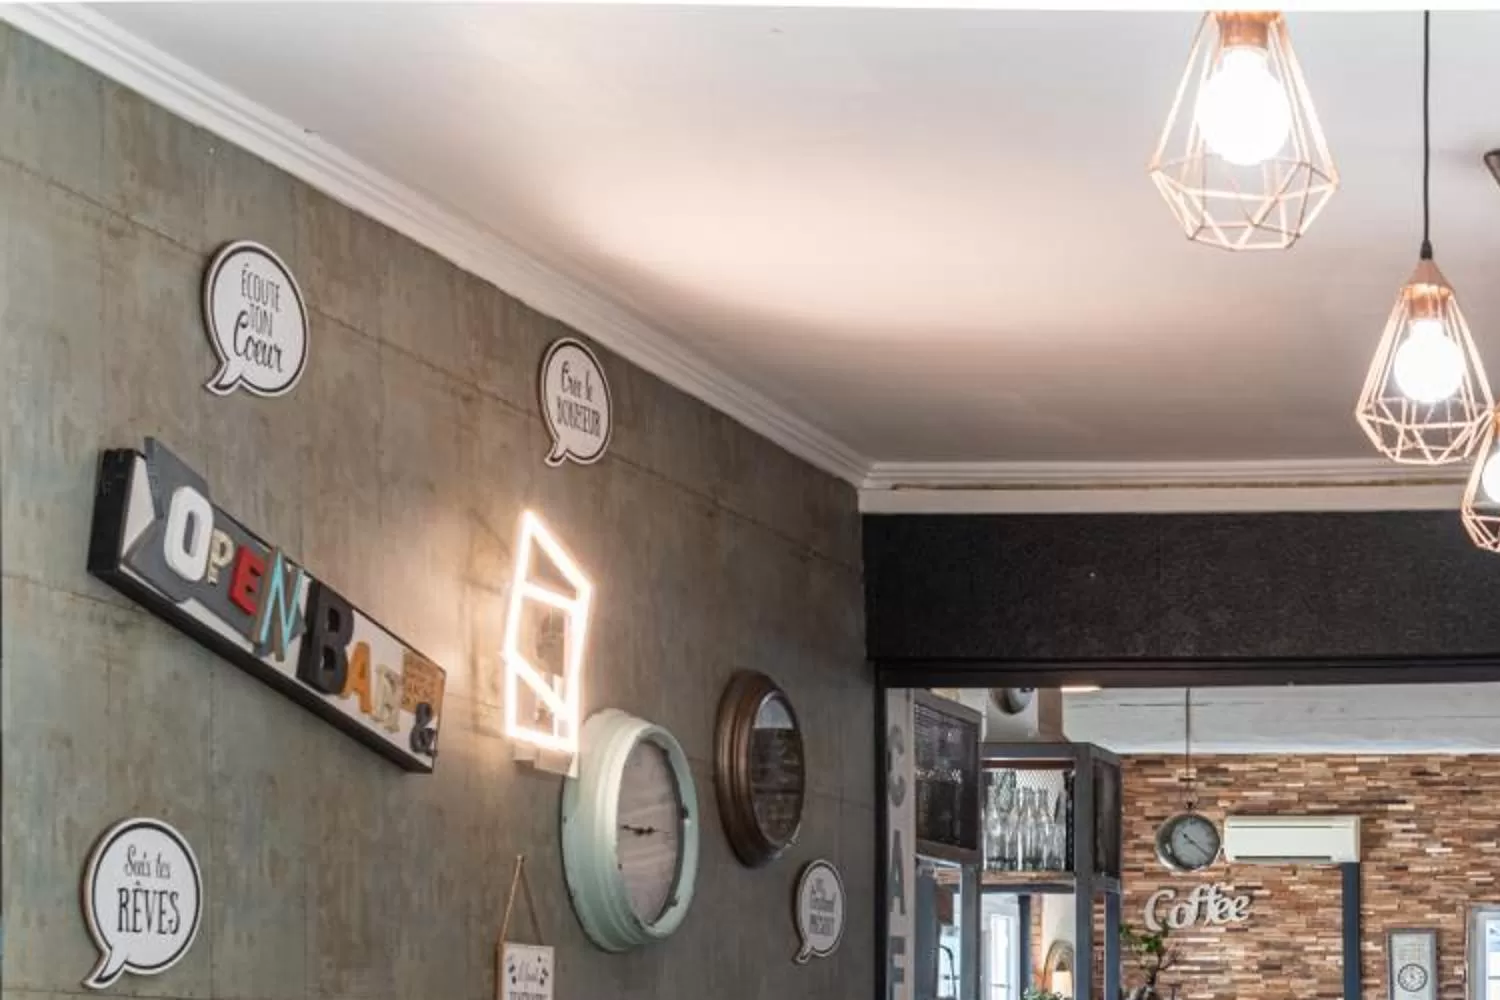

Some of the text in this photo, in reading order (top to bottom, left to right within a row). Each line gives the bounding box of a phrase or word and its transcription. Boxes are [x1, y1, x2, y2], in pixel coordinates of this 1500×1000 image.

[241, 263, 280, 312] ÉCOUTE
[249, 303, 273, 337] TON
[164, 485, 304, 663] OPEN
[296, 580, 402, 734] BAR
[117, 880, 181, 935] RÊVES
[1143, 884, 1251, 931] Coffee
